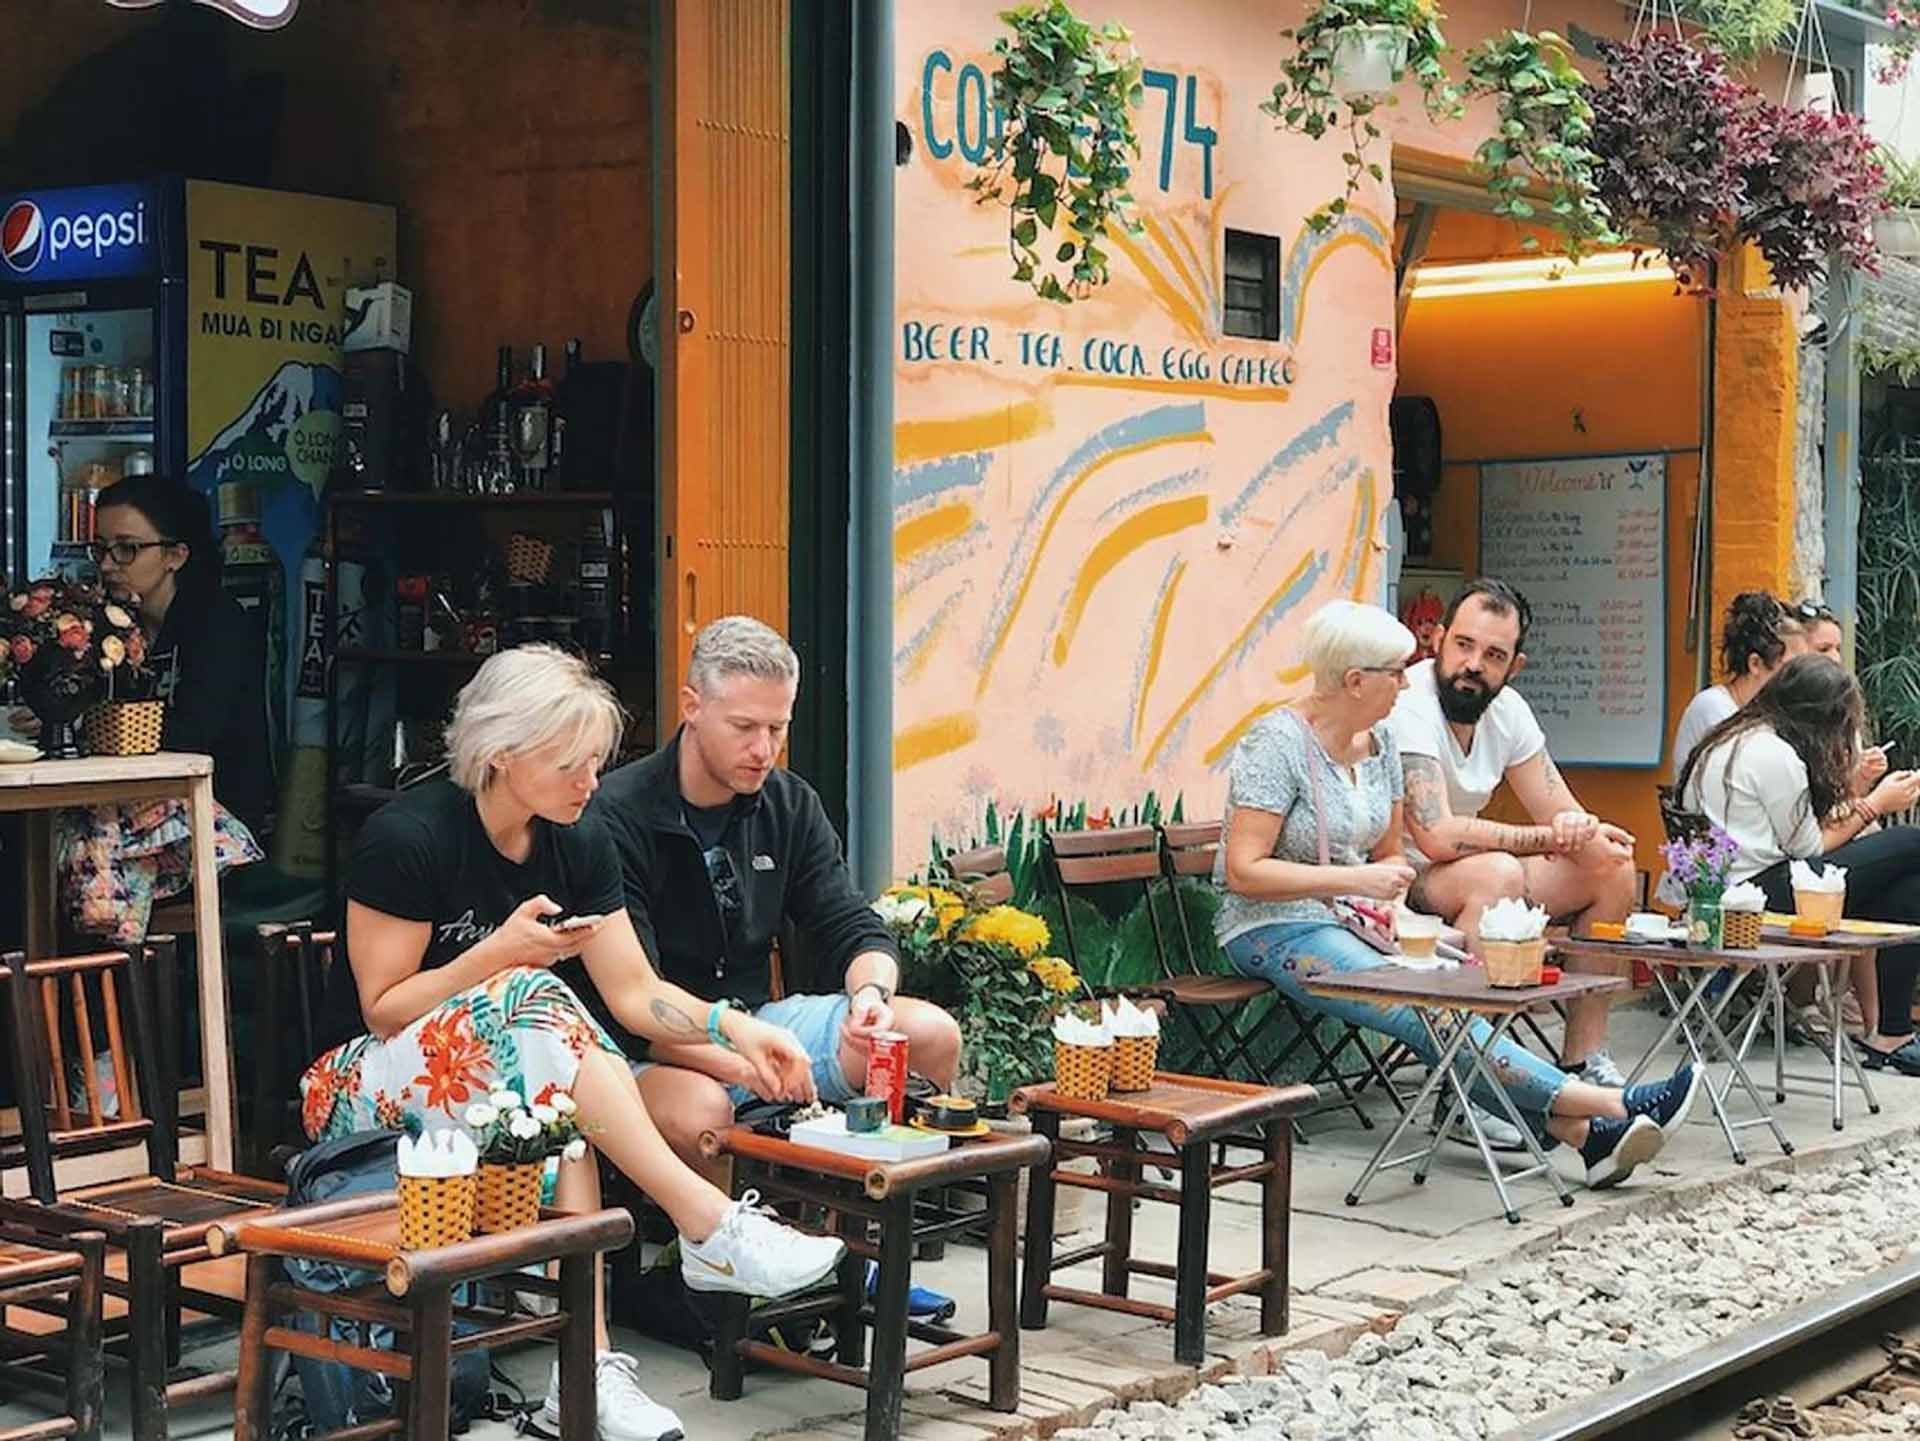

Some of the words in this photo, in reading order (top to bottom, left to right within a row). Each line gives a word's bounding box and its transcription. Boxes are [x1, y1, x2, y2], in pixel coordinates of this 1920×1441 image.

[1142, 68, 1217, 200] 74
[50, 201, 144, 261] pepsi
[202, 312, 251, 338] MUA
[260, 317, 281, 341] ĐI
[1162, 347, 1210, 380] EGG
[248, 456, 287, 472] LONG
